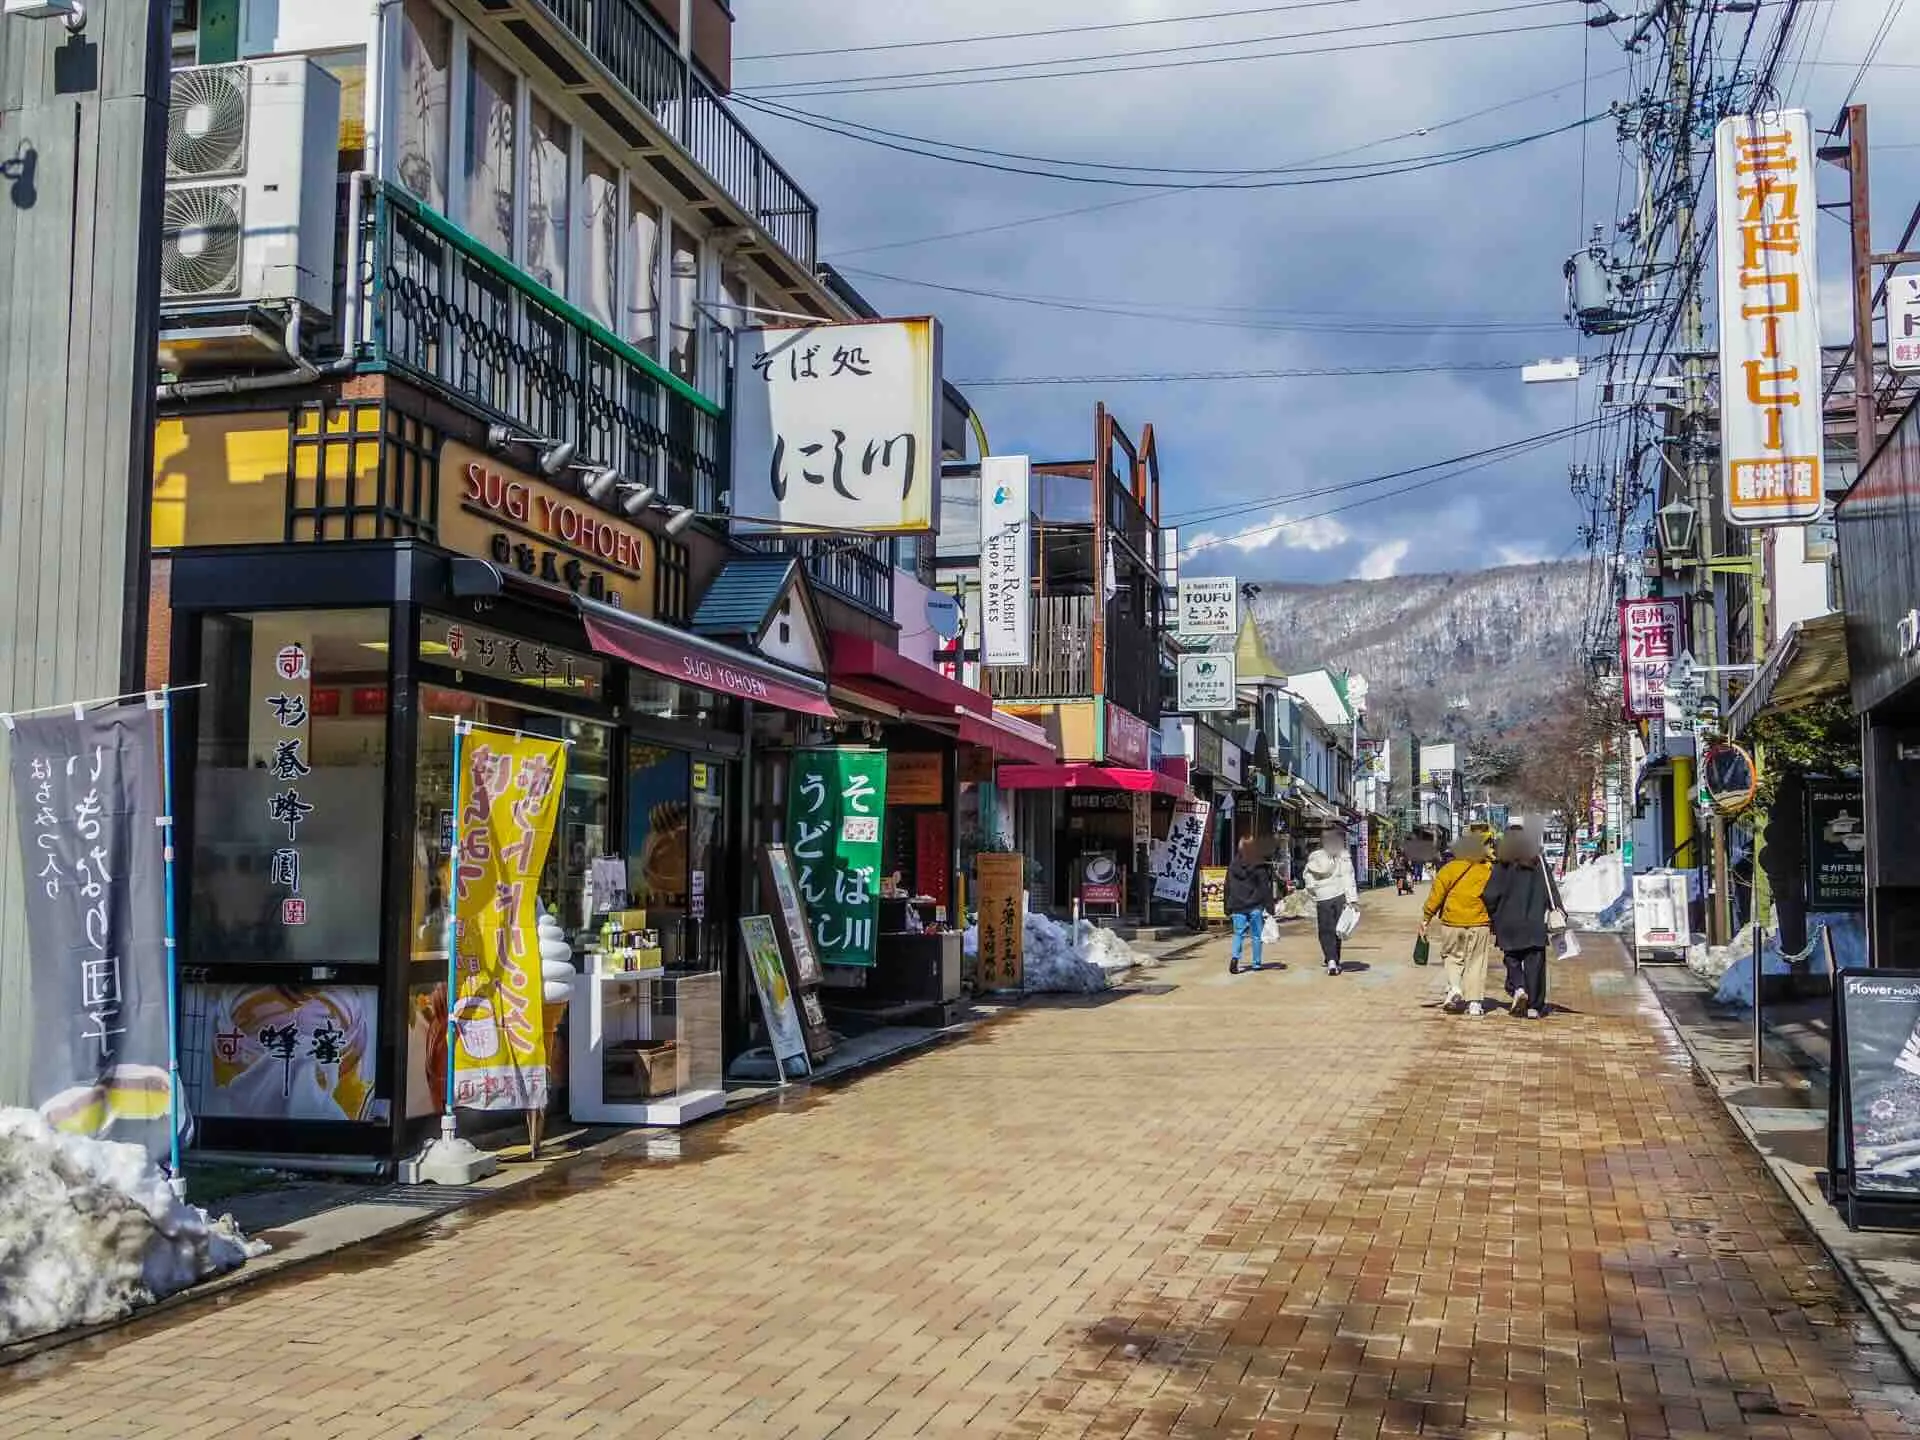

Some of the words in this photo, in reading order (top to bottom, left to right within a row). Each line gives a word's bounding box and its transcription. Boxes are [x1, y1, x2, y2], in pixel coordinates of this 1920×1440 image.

[1736, 131, 1800, 449] ミカドコーヒー
[752, 345, 872, 382] そば処
[770, 429, 916, 501] にし川
[466, 463, 532, 522] SUGI
[540, 495, 644, 571] YOHOEN
[988, 535, 999, 567] SHOP
[1003, 521, 1021, 573] PETER
[988, 583, 999, 623] BAKES
[1000, 577, 1020, 633] RABBIT
[1184, 592, 1232, 604] TOUFU
[1188, 606, 1229, 619] とうふ
[1631, 607, 1675, 625] 信州の
[1632, 624, 1675, 658] 酒
[682, 655, 712, 681] SUGI
[716, 666, 768, 697] YOHOEN
[265, 691, 315, 894] 杉養蜂園
[793, 774, 832, 903] うどん
[834, 775, 876, 904] そば
[808, 913, 872, 951] し川
[1849, 983, 1892, 995] Flower
[257, 1018, 348, 1097] 蜂蜜
